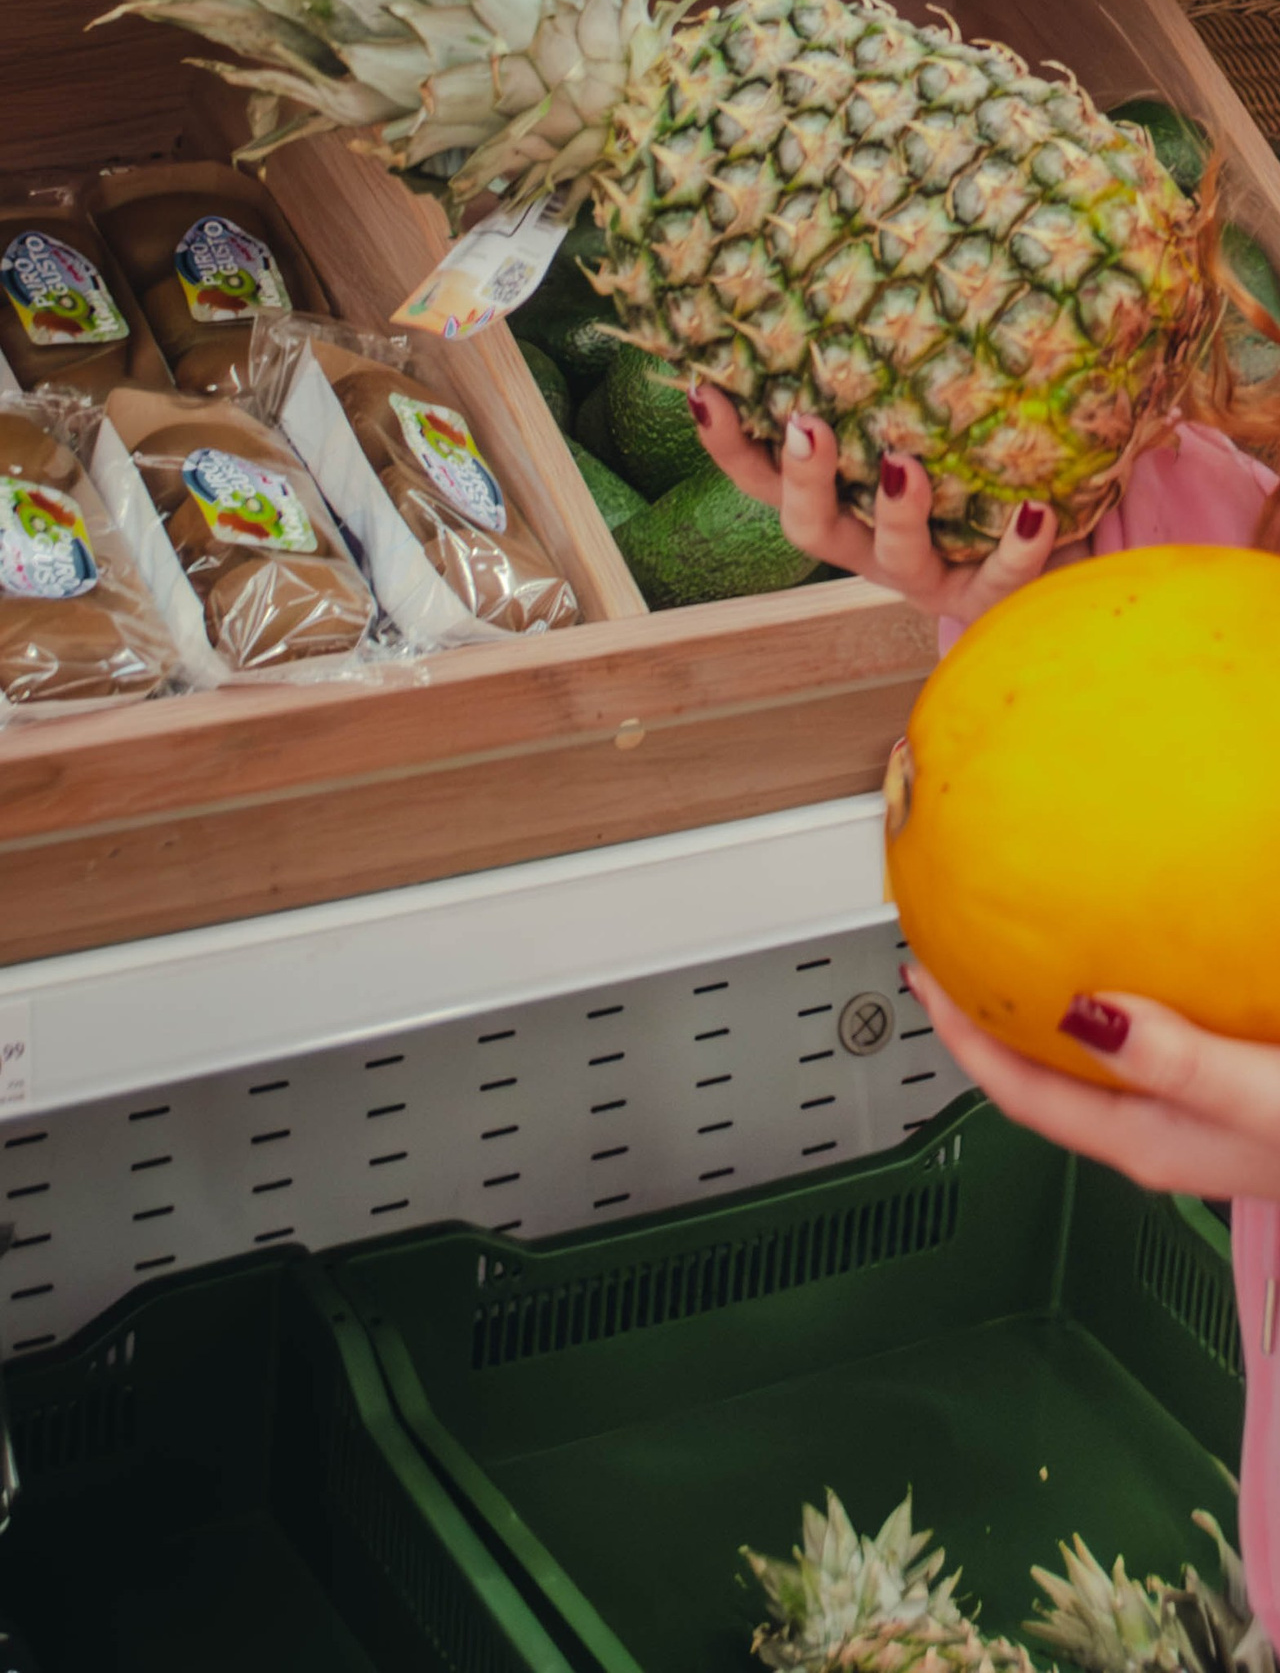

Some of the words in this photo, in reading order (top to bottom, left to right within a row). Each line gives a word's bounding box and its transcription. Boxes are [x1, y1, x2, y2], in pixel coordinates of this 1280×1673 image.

[25, 235, 68, 296] GUSTO
[190, 243, 222, 286] PURO
[204, 221, 239, 276] GUSTO
[14, 258, 55, 308] PURO
